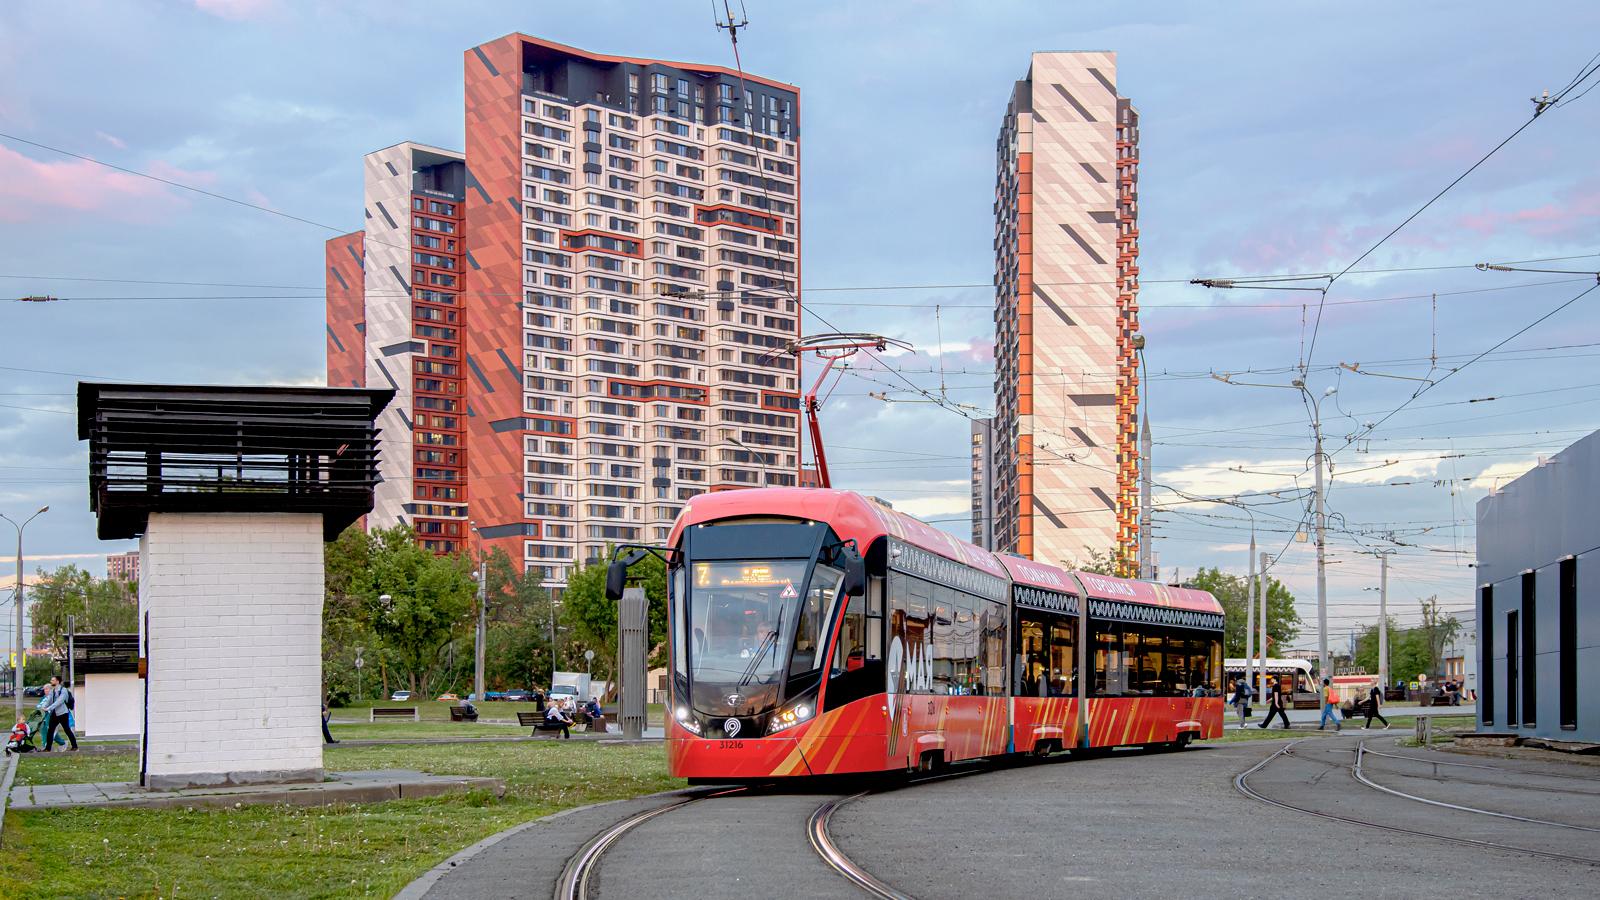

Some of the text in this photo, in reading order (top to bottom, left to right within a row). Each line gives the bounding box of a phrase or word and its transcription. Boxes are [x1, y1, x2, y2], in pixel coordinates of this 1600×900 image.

[1086, 576, 1137, 597] ГОРДИМСЯ
[906, 641, 933, 691] МАЯ
[719, 740, 744, 749] 31216
